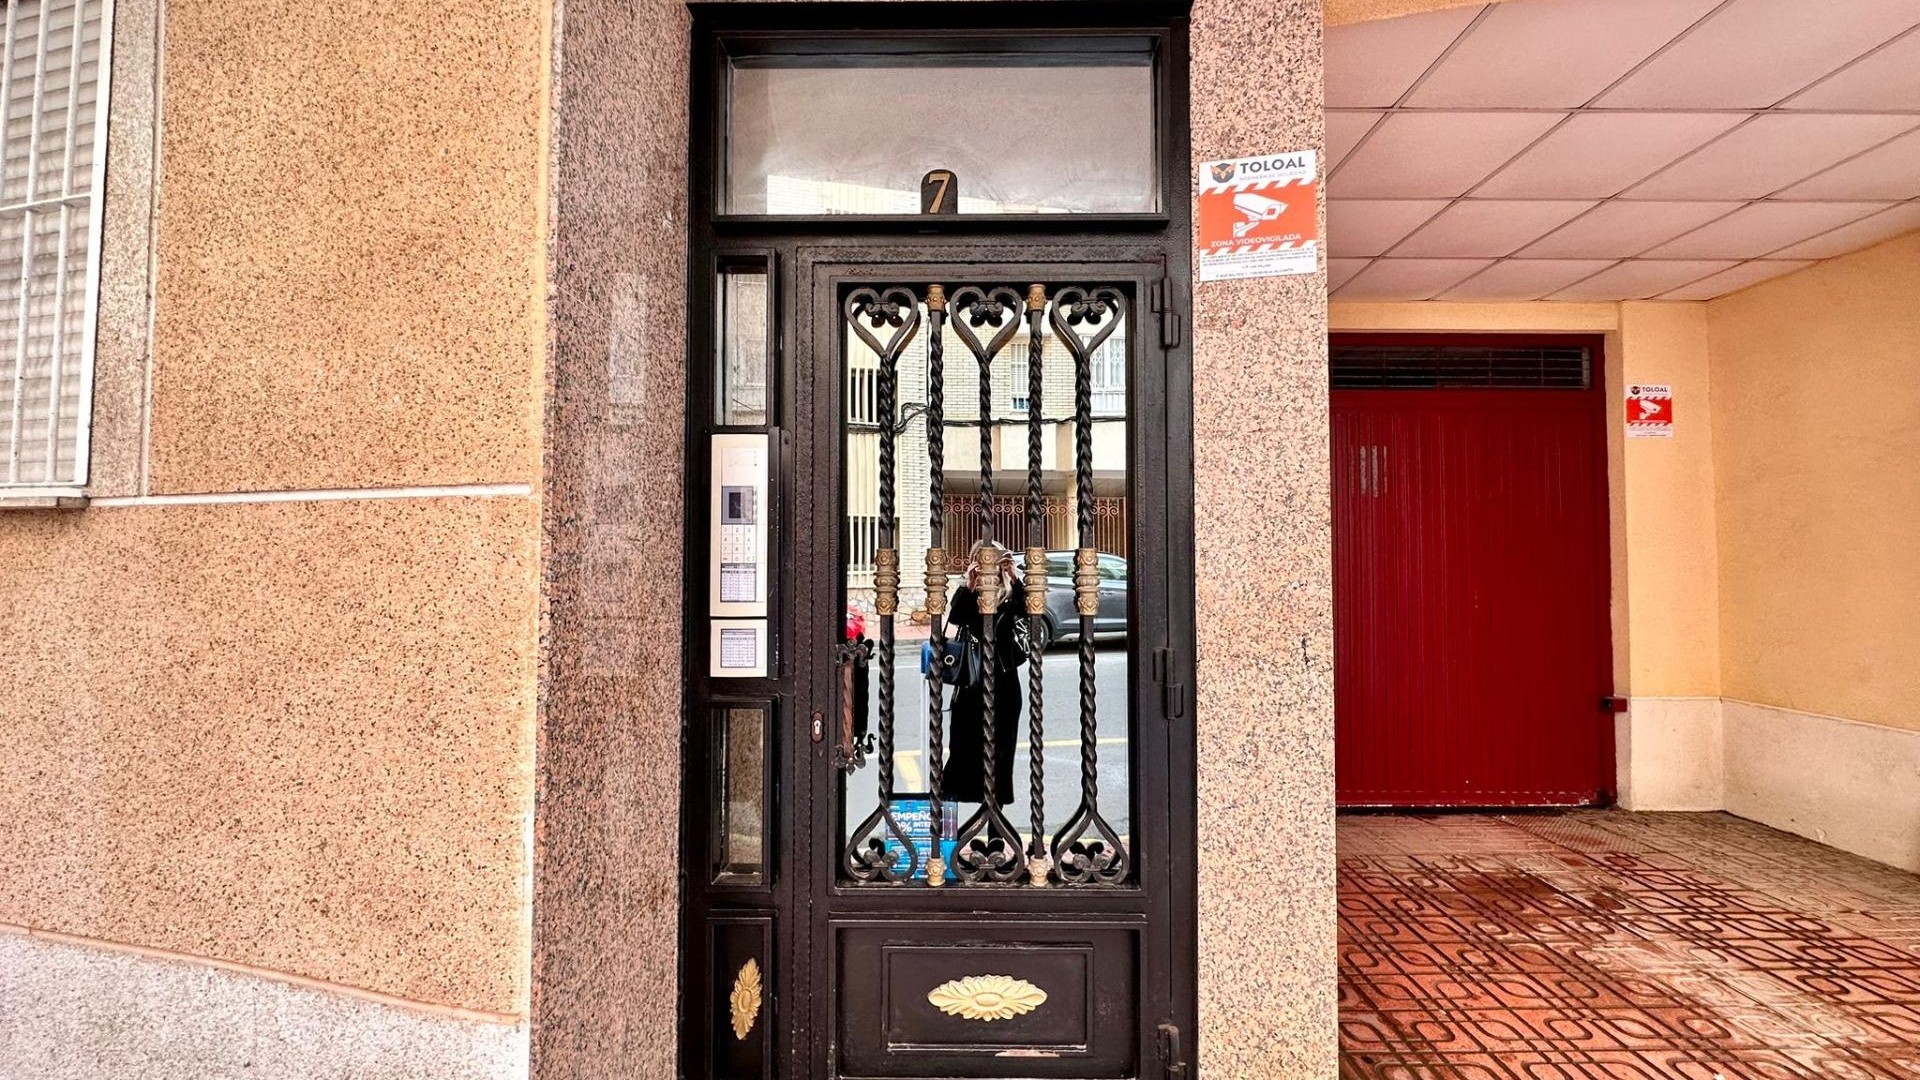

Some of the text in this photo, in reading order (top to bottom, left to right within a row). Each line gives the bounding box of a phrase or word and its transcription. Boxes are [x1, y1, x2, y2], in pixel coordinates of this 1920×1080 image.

[1240, 156, 1306, 174] TOLOAL
[928, 172, 951, 214] 7
[1211, 233, 1301, 248] ZONA VIDEOVIGILADA
